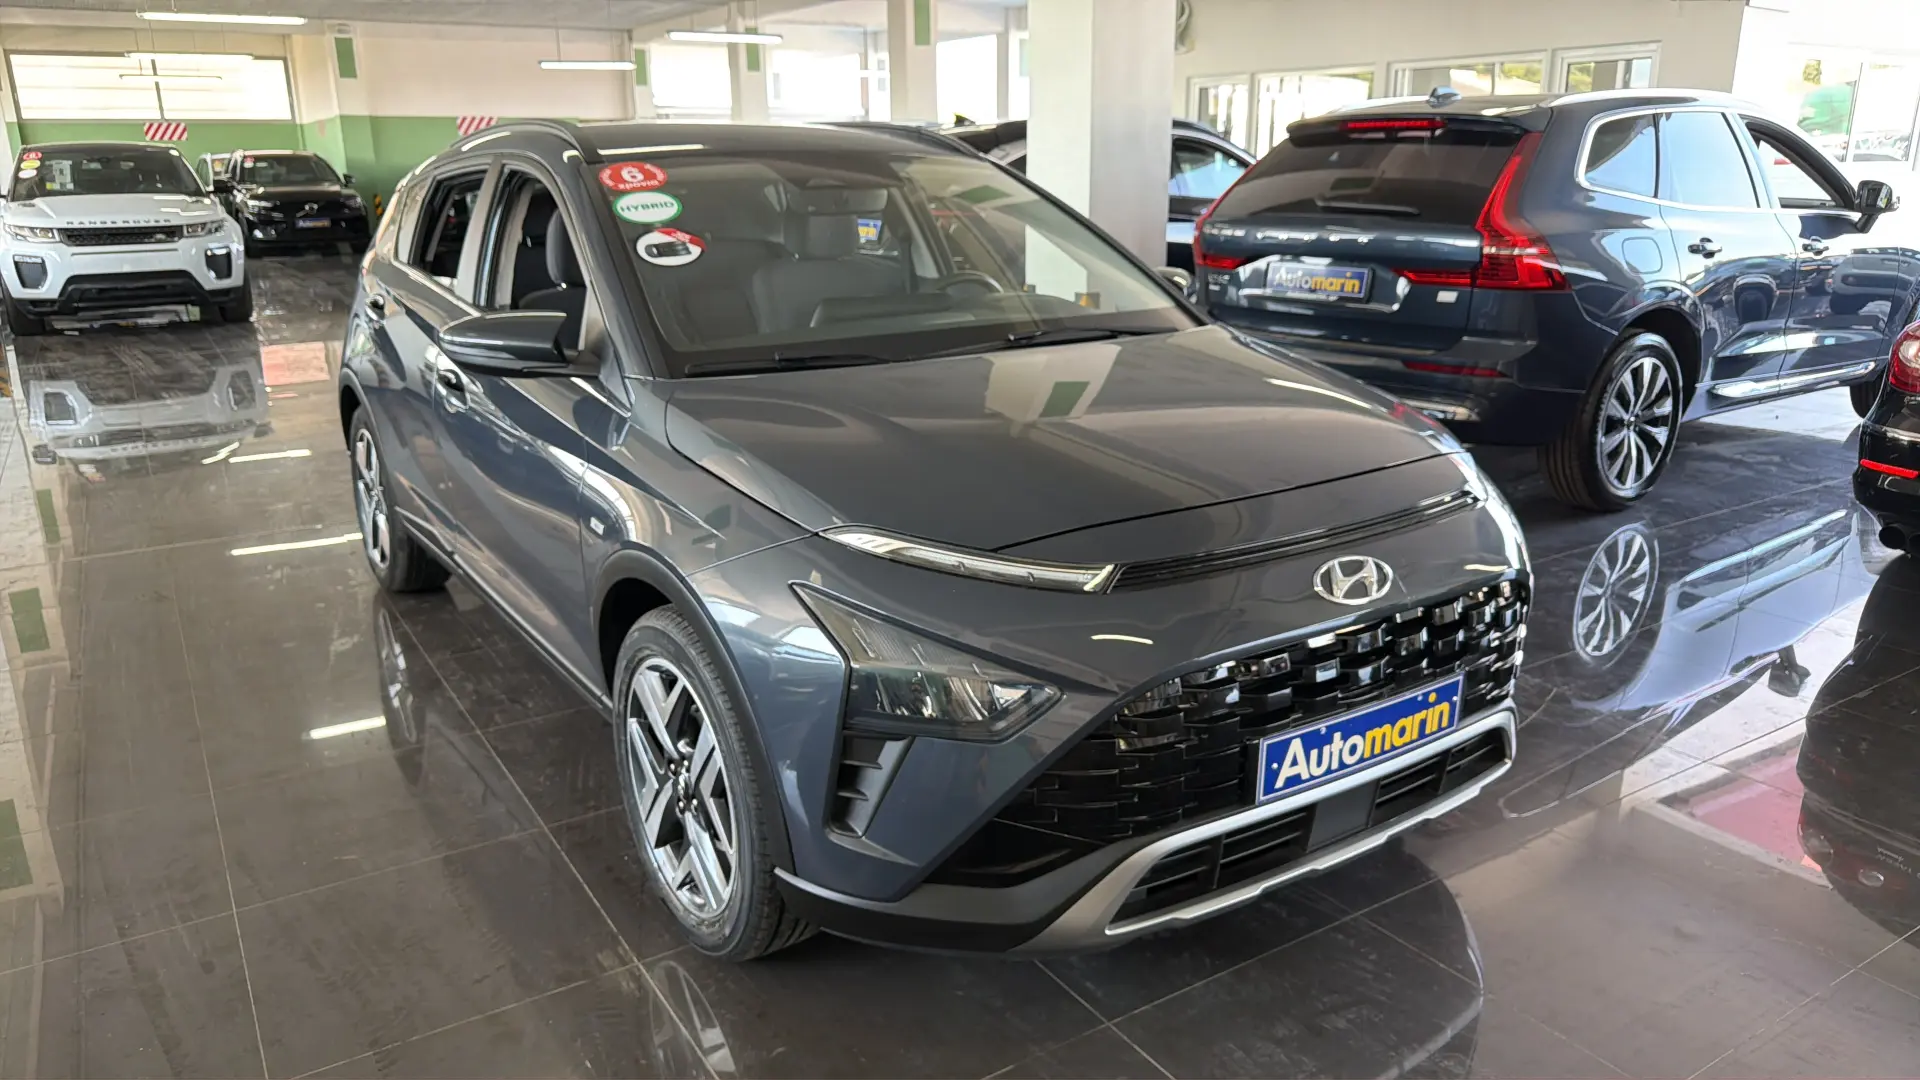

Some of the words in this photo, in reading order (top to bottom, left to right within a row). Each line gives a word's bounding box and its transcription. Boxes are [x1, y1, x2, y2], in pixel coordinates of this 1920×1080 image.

[620, 165, 644, 182] 6
[619, 200, 675, 213] HYBRID
[1273, 266, 1361, 294] Automarin
[1274, 691, 1451, 790] Automarin
